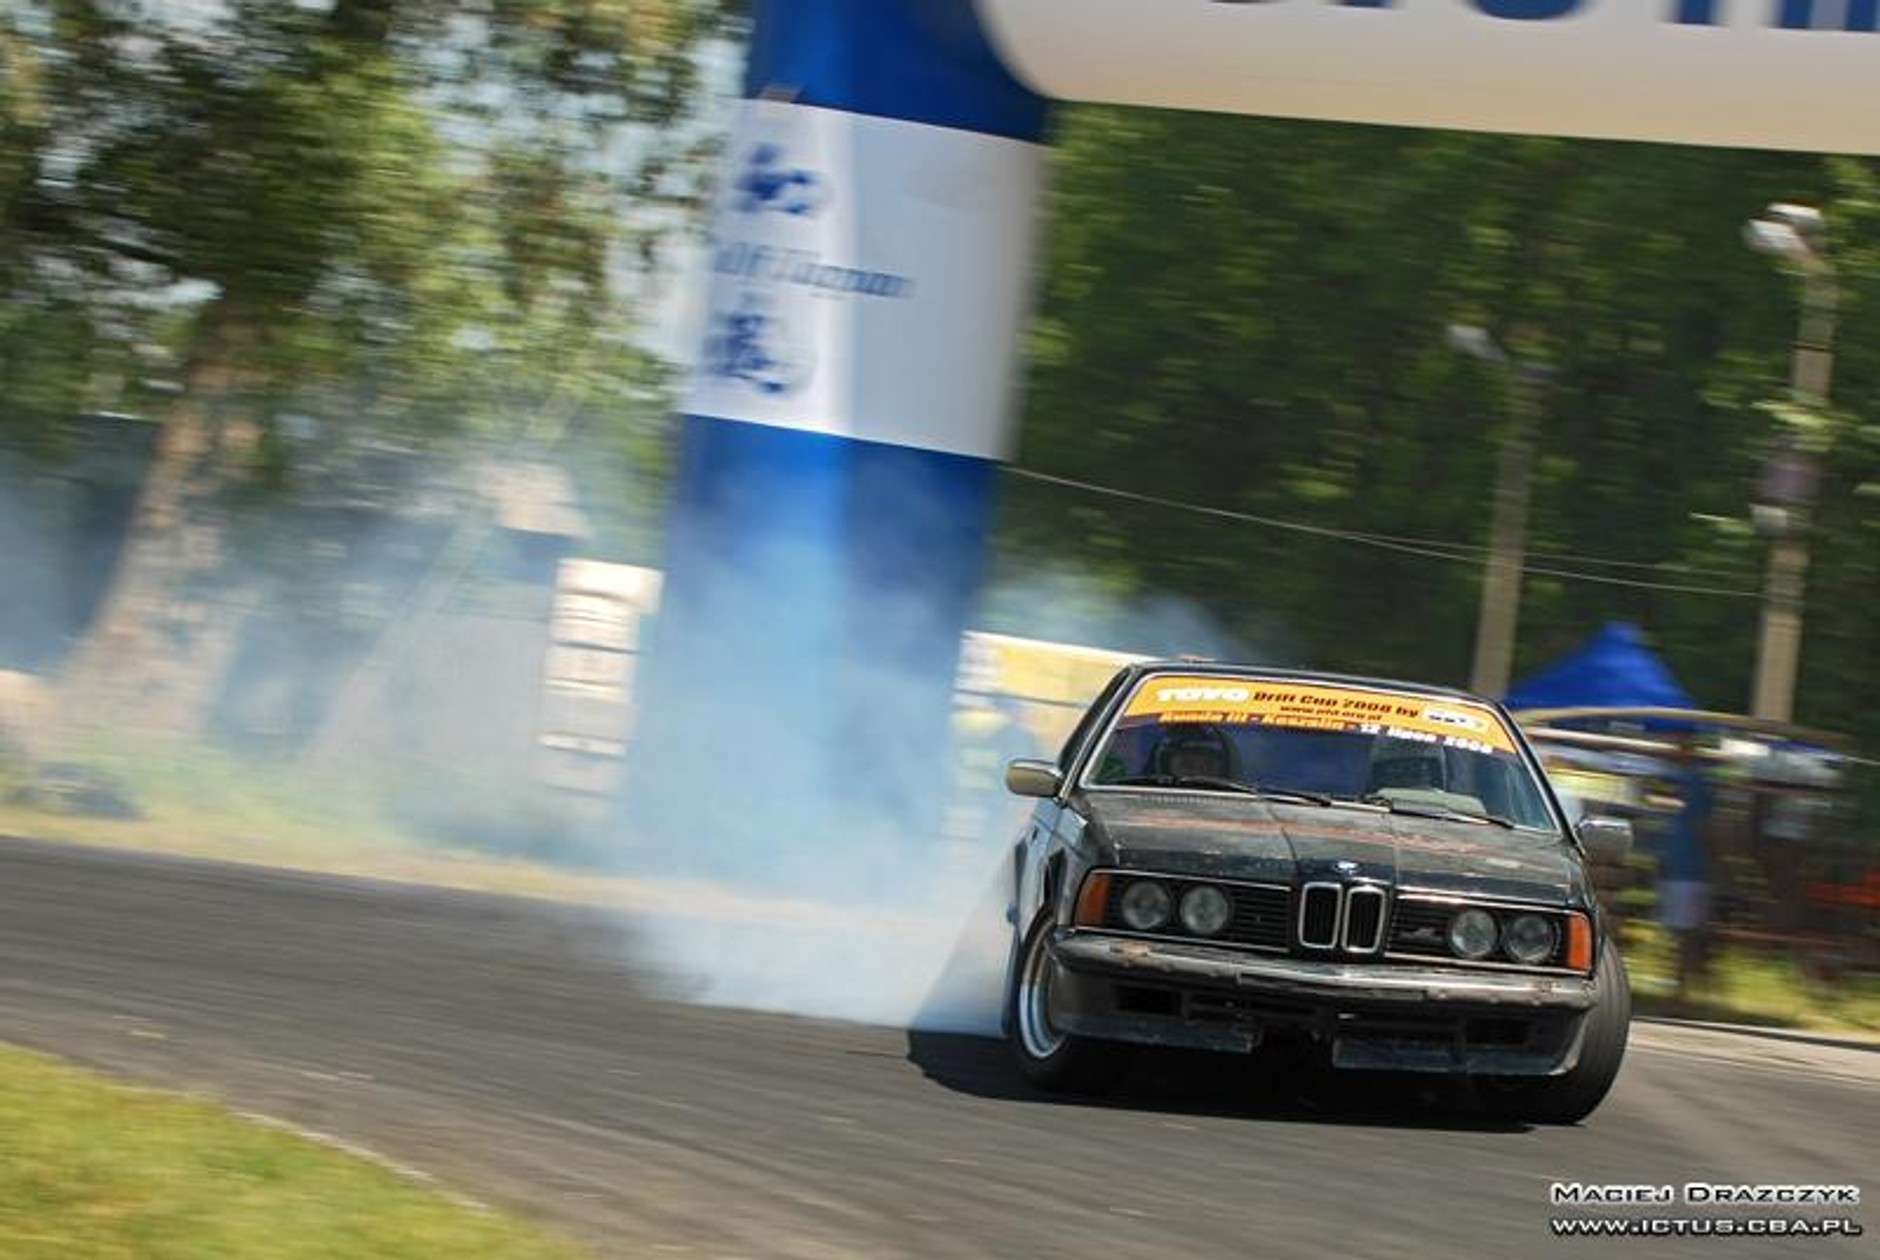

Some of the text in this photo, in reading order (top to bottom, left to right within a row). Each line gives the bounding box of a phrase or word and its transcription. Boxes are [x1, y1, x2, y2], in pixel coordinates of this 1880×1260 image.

[1254, 691, 1296, 702] Drift
[1300, 694, 1338, 707] Cup
[1343, 698, 1392, 712] 2008
[1396, 705, 1418, 718] by
